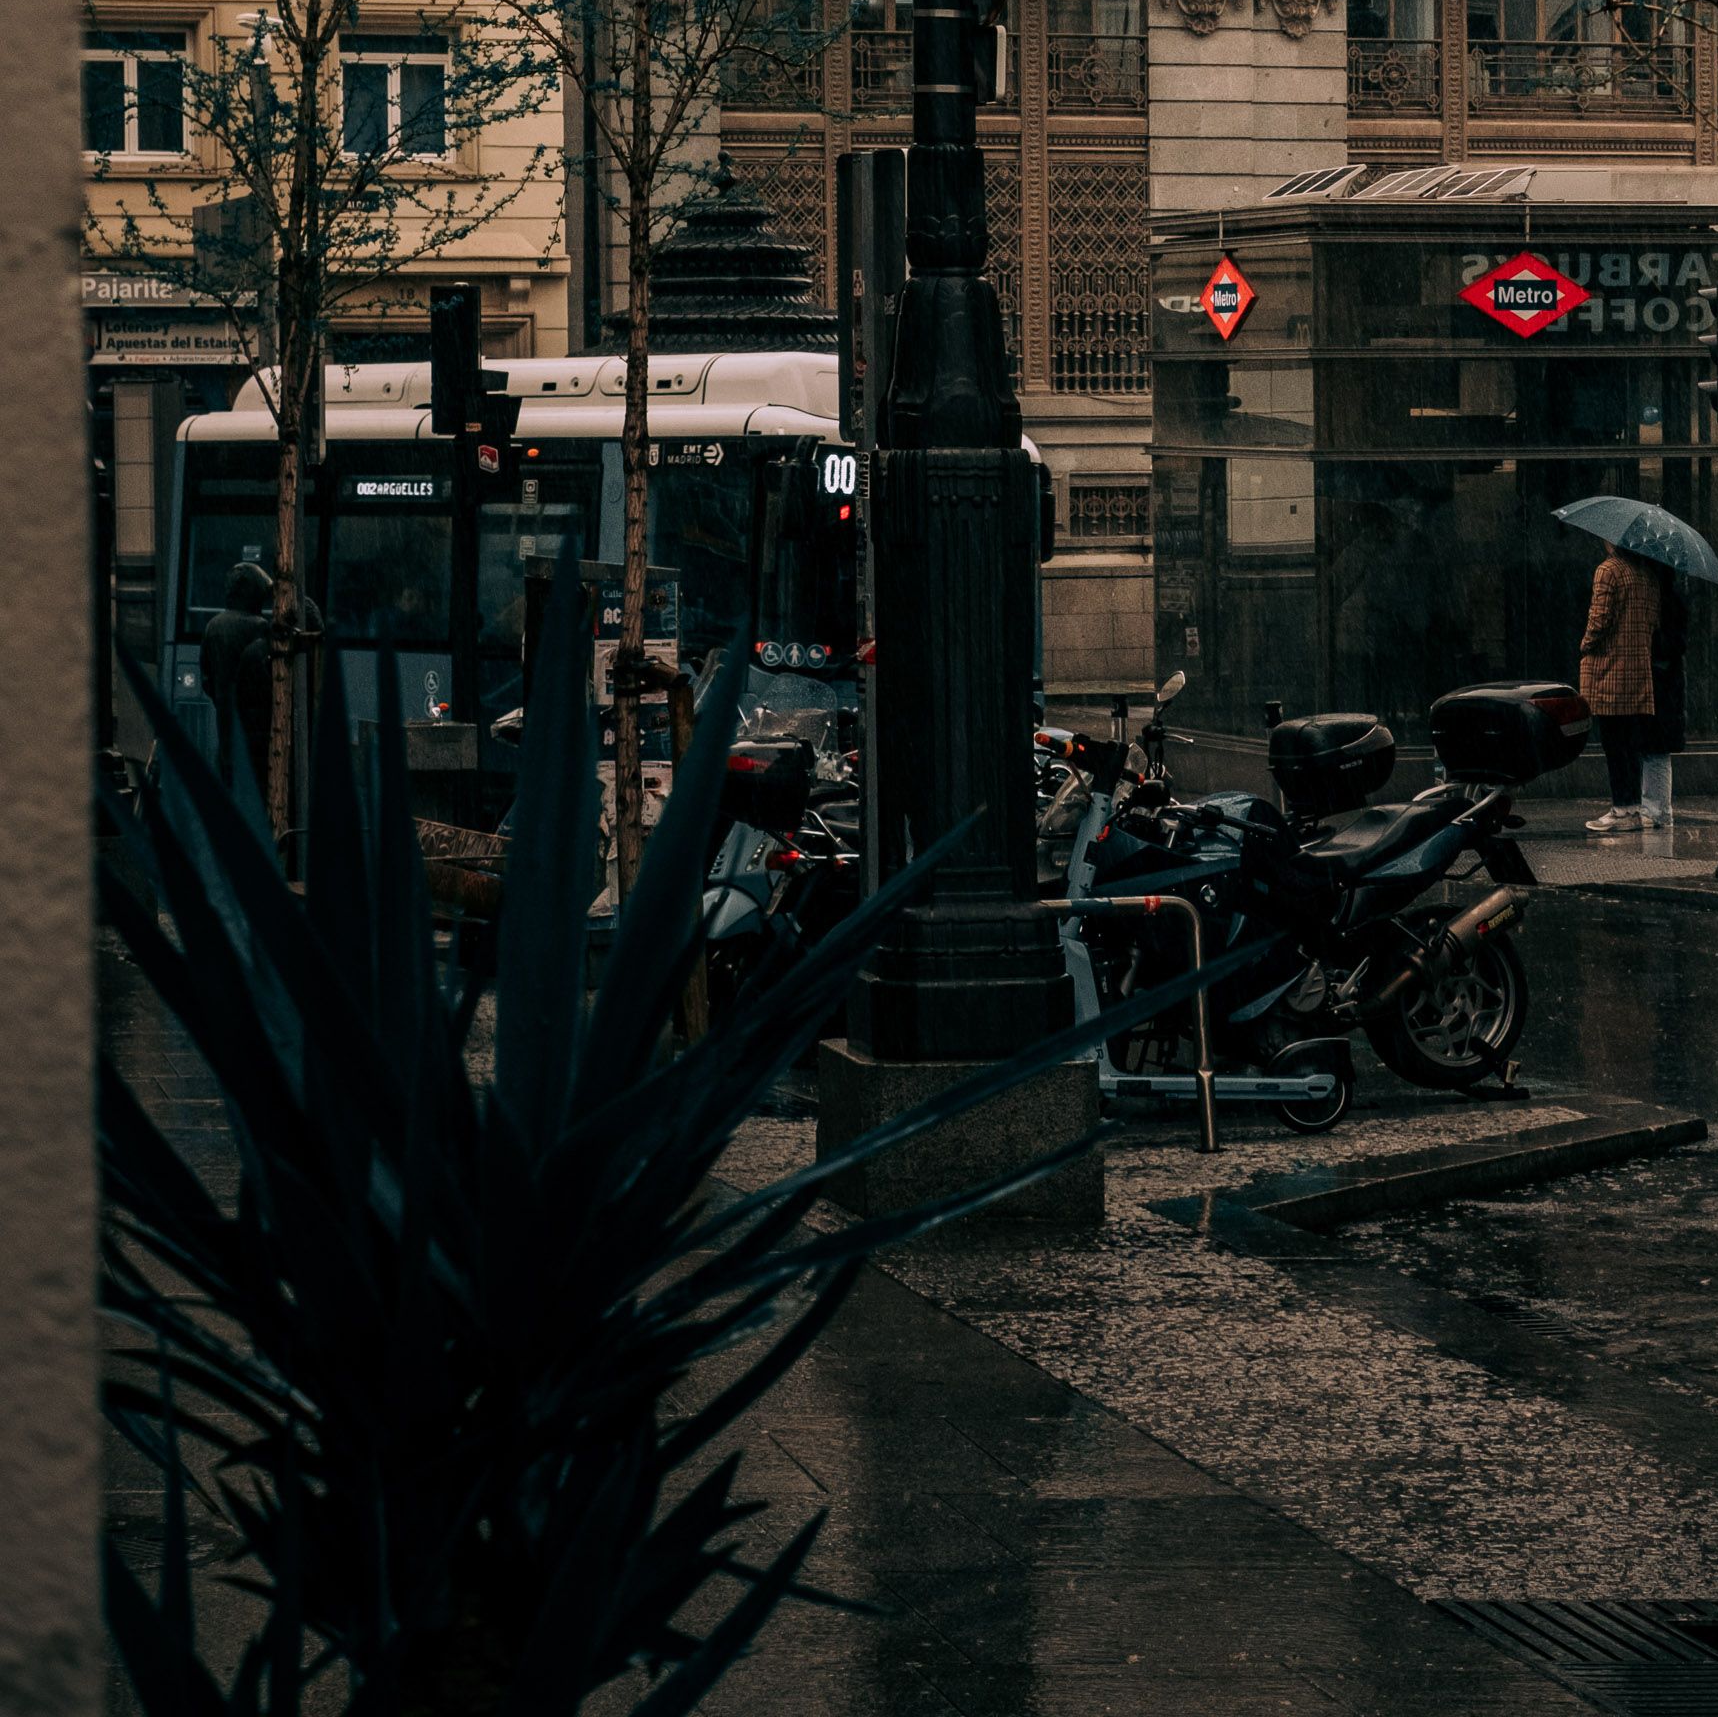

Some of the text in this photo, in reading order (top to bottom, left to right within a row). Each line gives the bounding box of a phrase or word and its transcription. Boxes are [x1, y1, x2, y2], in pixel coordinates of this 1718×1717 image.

[1213, 290, 1237, 307] Metro
[1498, 286, 1554, 305] Metro
[105, 338, 167, 352] Apuestas
[170, 337, 191, 349] del
[683, 444, 701, 454] EMT
[667, 454, 701, 465] MADRID
[824, 453, 856, 495] 00
